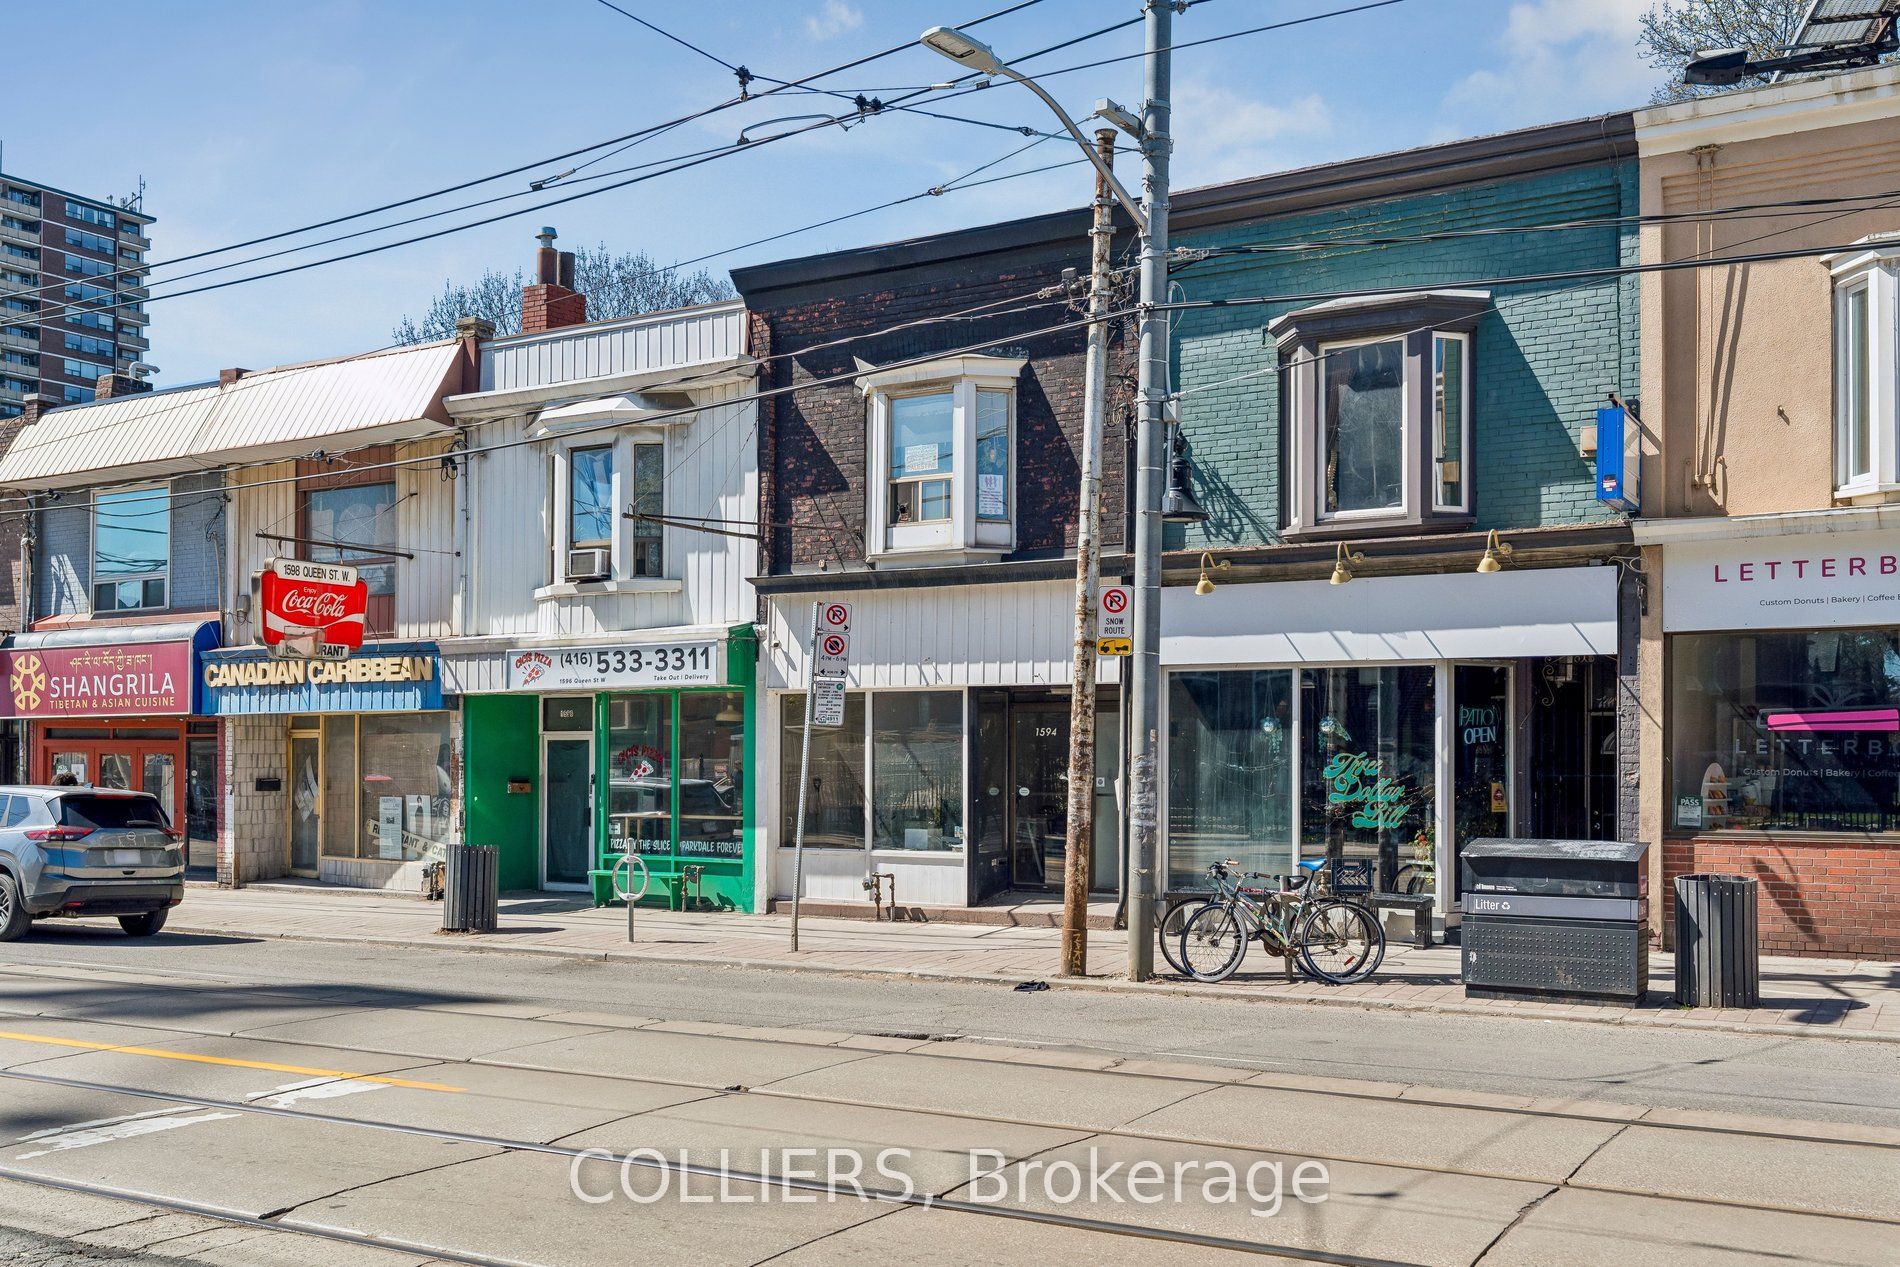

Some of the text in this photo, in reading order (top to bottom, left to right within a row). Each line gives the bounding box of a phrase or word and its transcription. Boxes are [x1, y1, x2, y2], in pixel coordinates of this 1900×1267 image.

[284, 564, 350, 582] 1598 QUEEN ST. W.
[1714, 556, 1897, 582] LETTERB
[282, 590, 348, 617] Coca-Cola
[534, 652, 552, 668] PIZZA
[560, 647, 710, 674] (416) 533-3311
[204, 656, 433, 687] CANADIAN CARIBBEAN
[50, 672, 175, 698] SHANGRILA
[50, 697, 174, 710] TIBETAN & ASIAN CUISINE
[1460, 708, 1494, 726] PATIO
[1036, 727, 1057, 736] 1594
[1464, 726, 1496, 744] OPEN
[1323, 752, 1383, 779] Three
[1743, 768, 1779, 776] Custom
[1783, 768, 1818, 776] Donuts
[1826, 768, 1860, 778] Bakery
[1329, 773, 1405, 803] Dollar
[1352, 800, 1410, 828] Bill
[422, 842, 428, 852] &
[610, 838, 627, 849] PIZZA
[639, 840, 650, 850] THE
[653, 840, 670, 850] SLICE
[1475, 899, 1500, 910] Litter
